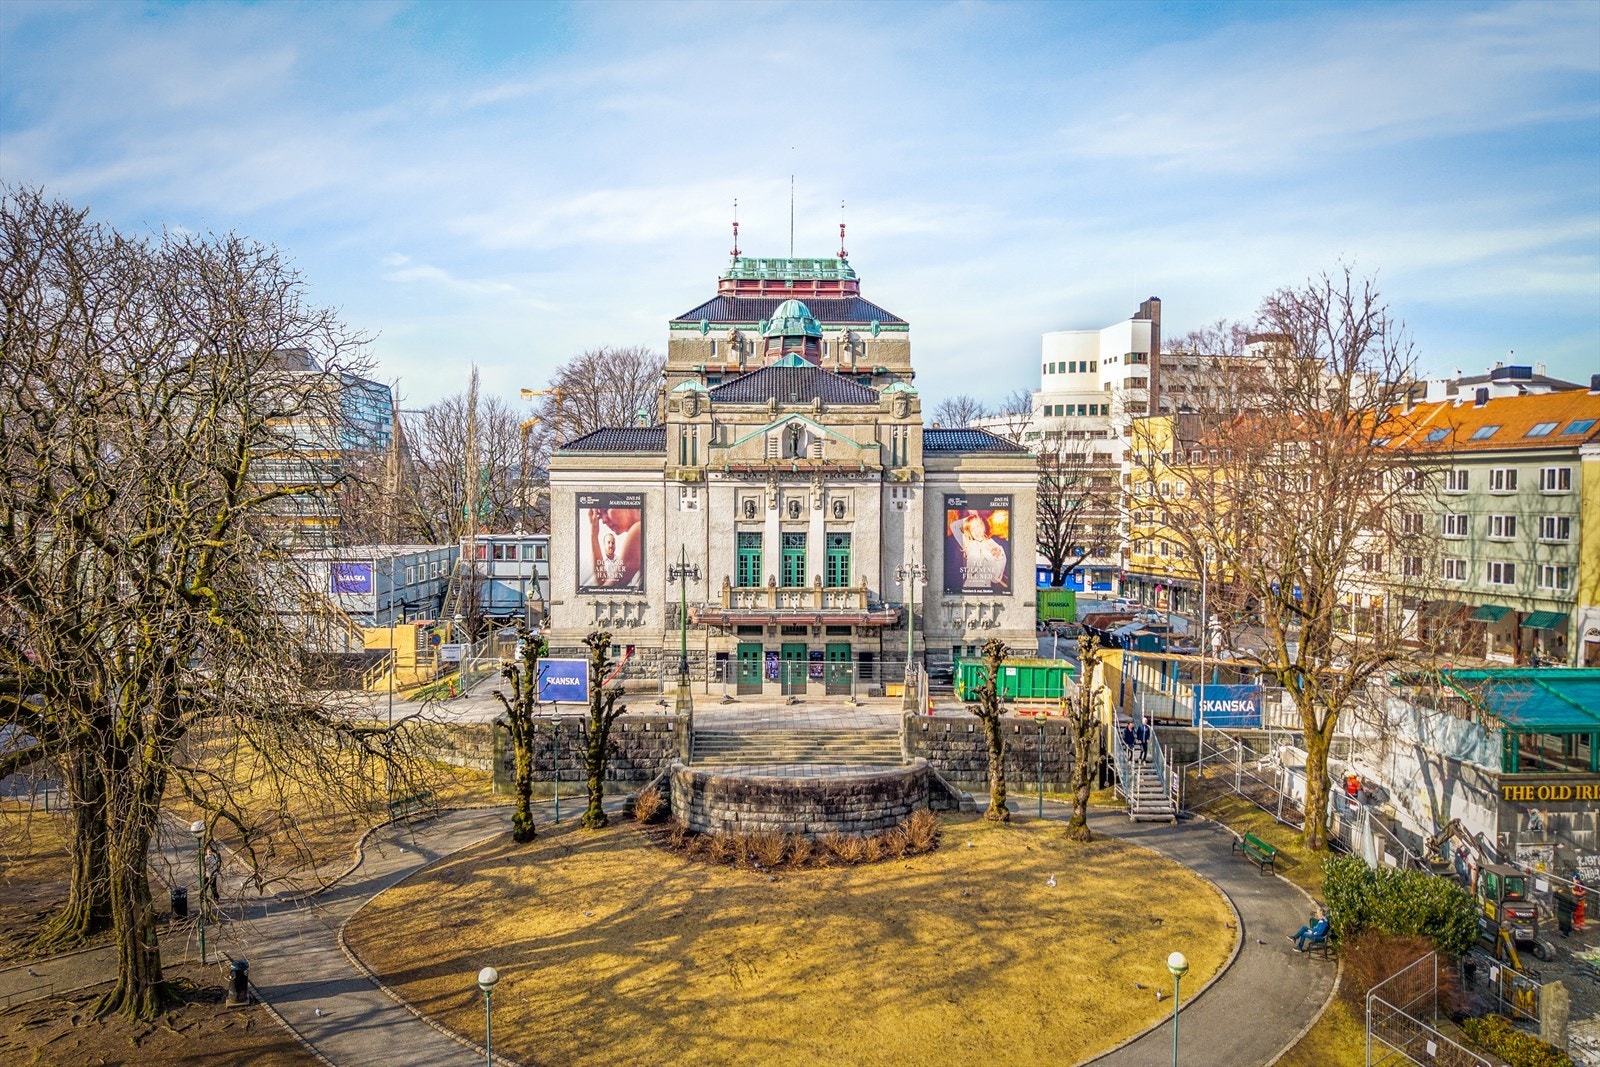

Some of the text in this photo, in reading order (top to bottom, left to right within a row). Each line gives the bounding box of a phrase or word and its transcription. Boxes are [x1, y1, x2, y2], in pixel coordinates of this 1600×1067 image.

[546, 677, 580, 686] SKANSKA
[1199, 700, 1255, 712] SKANSKA
[1501, 784, 1600, 801] THE OLD IRI
